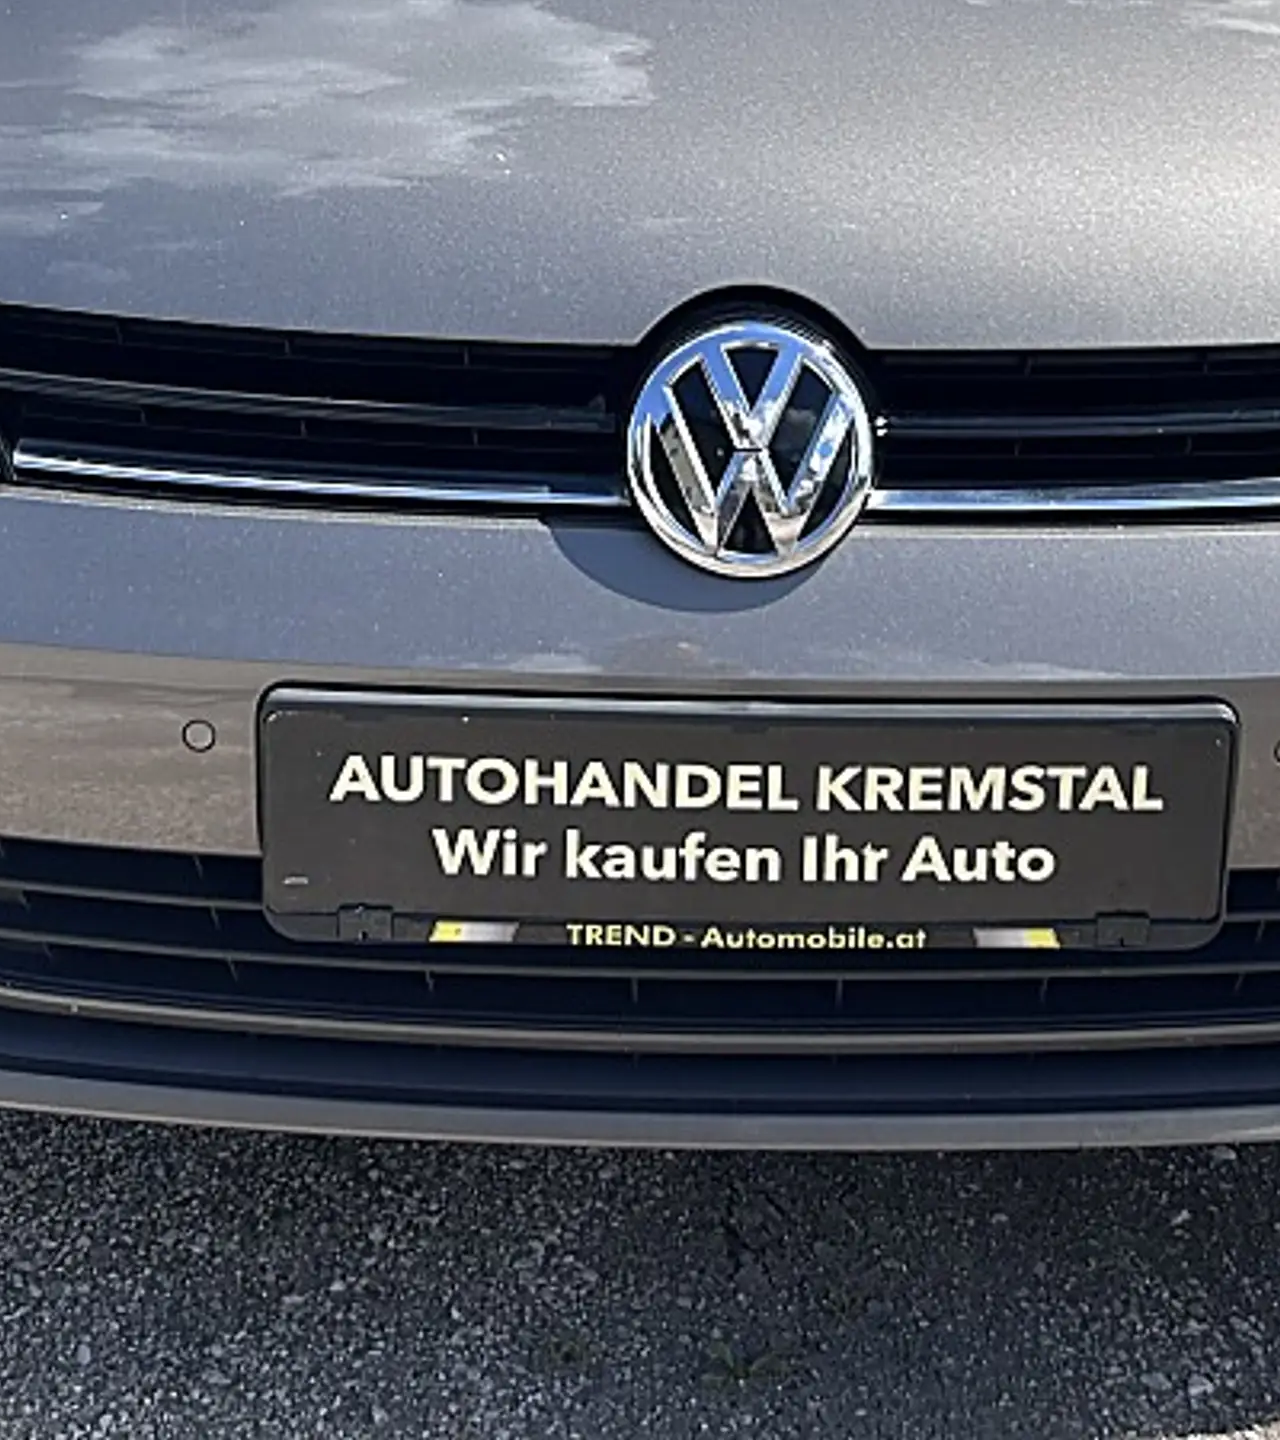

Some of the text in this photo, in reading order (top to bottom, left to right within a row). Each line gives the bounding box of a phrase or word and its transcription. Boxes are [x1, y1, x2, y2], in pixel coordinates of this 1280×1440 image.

[631, 323, 869, 575] VW
[328, 754, 1164, 812] AUTOHANDEL KREMSTAL
[432, 827, 1056, 883] Wir kaufen Ihr Auto
[566, 923, 676, 947] TREND
[700, 926, 927, 949] Automobile.at
